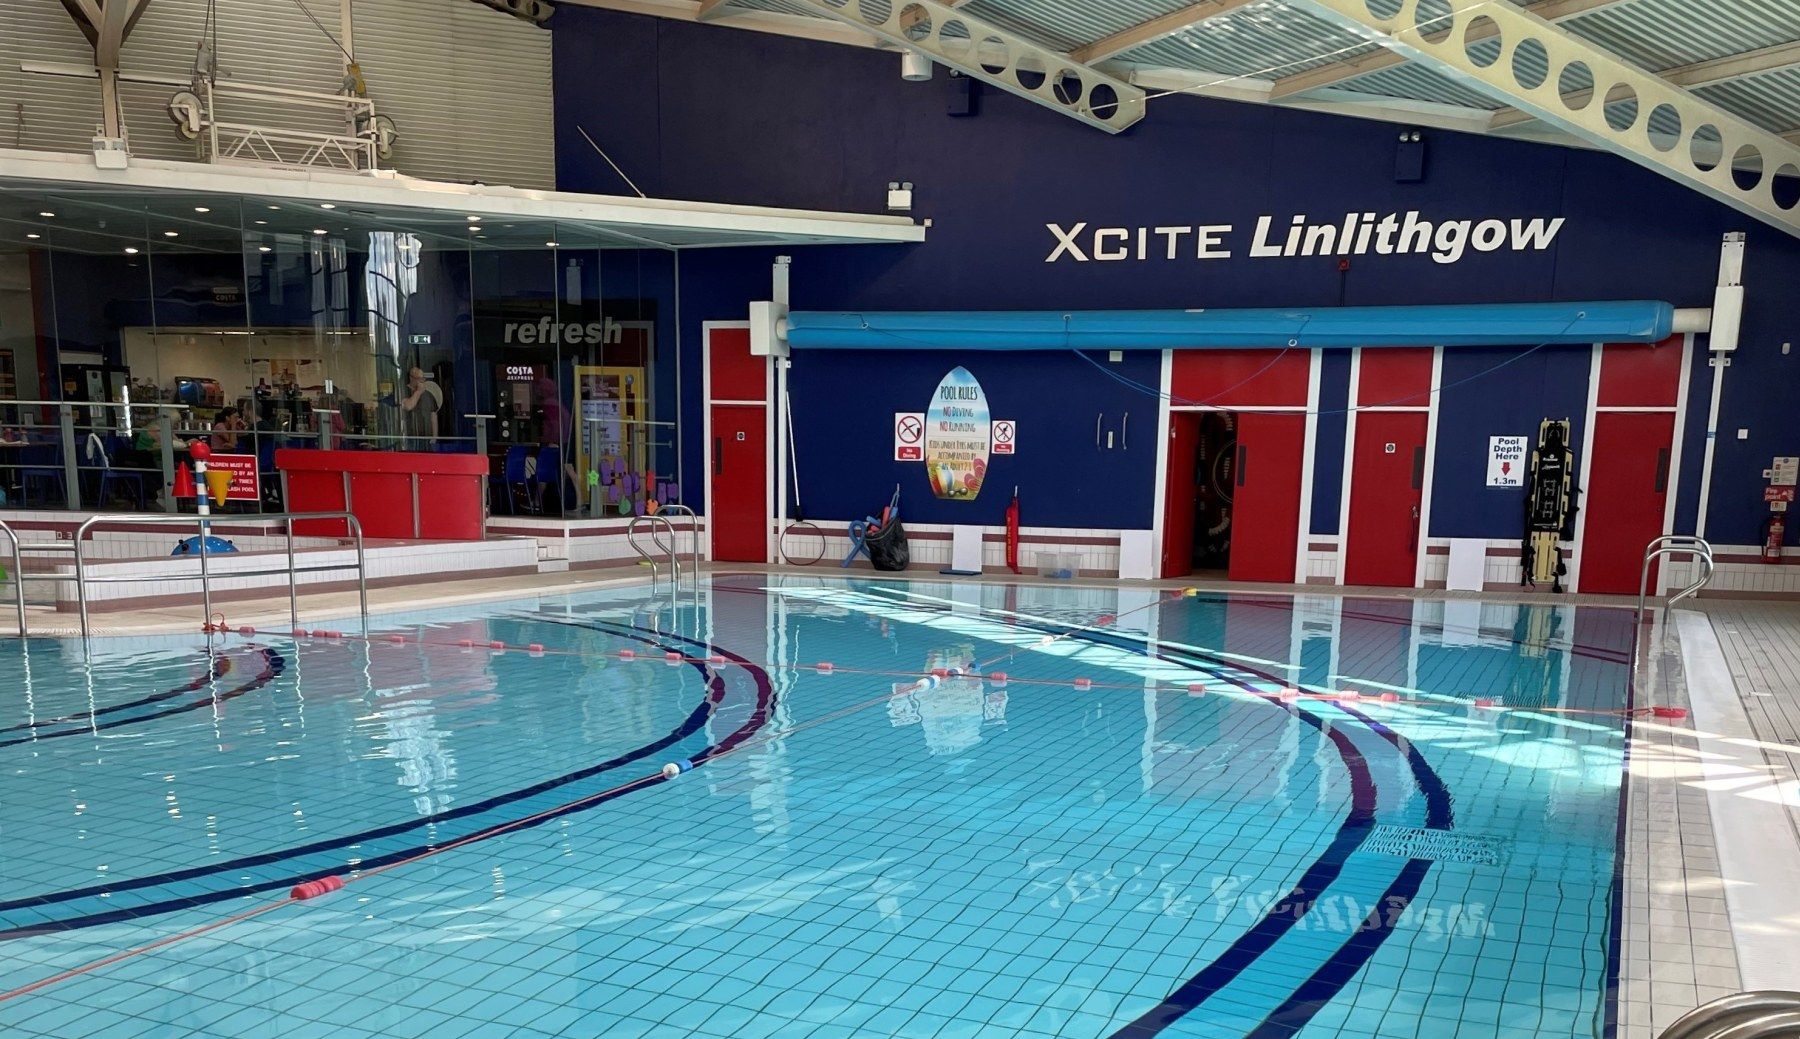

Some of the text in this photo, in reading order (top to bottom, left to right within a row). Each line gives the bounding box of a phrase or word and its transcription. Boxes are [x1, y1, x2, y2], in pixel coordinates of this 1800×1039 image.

[1045, 210, 1565, 264] XCITE Linlithgow
[504, 316, 622, 344] refresh
[506, 366, 534, 375] COSTA
[940, 386, 978, 401] POOL RULES
[943, 406, 974, 418] NO DIVING
[939, 421, 976, 433] NO RUNNING
[1493, 445, 1523, 454] Depth
